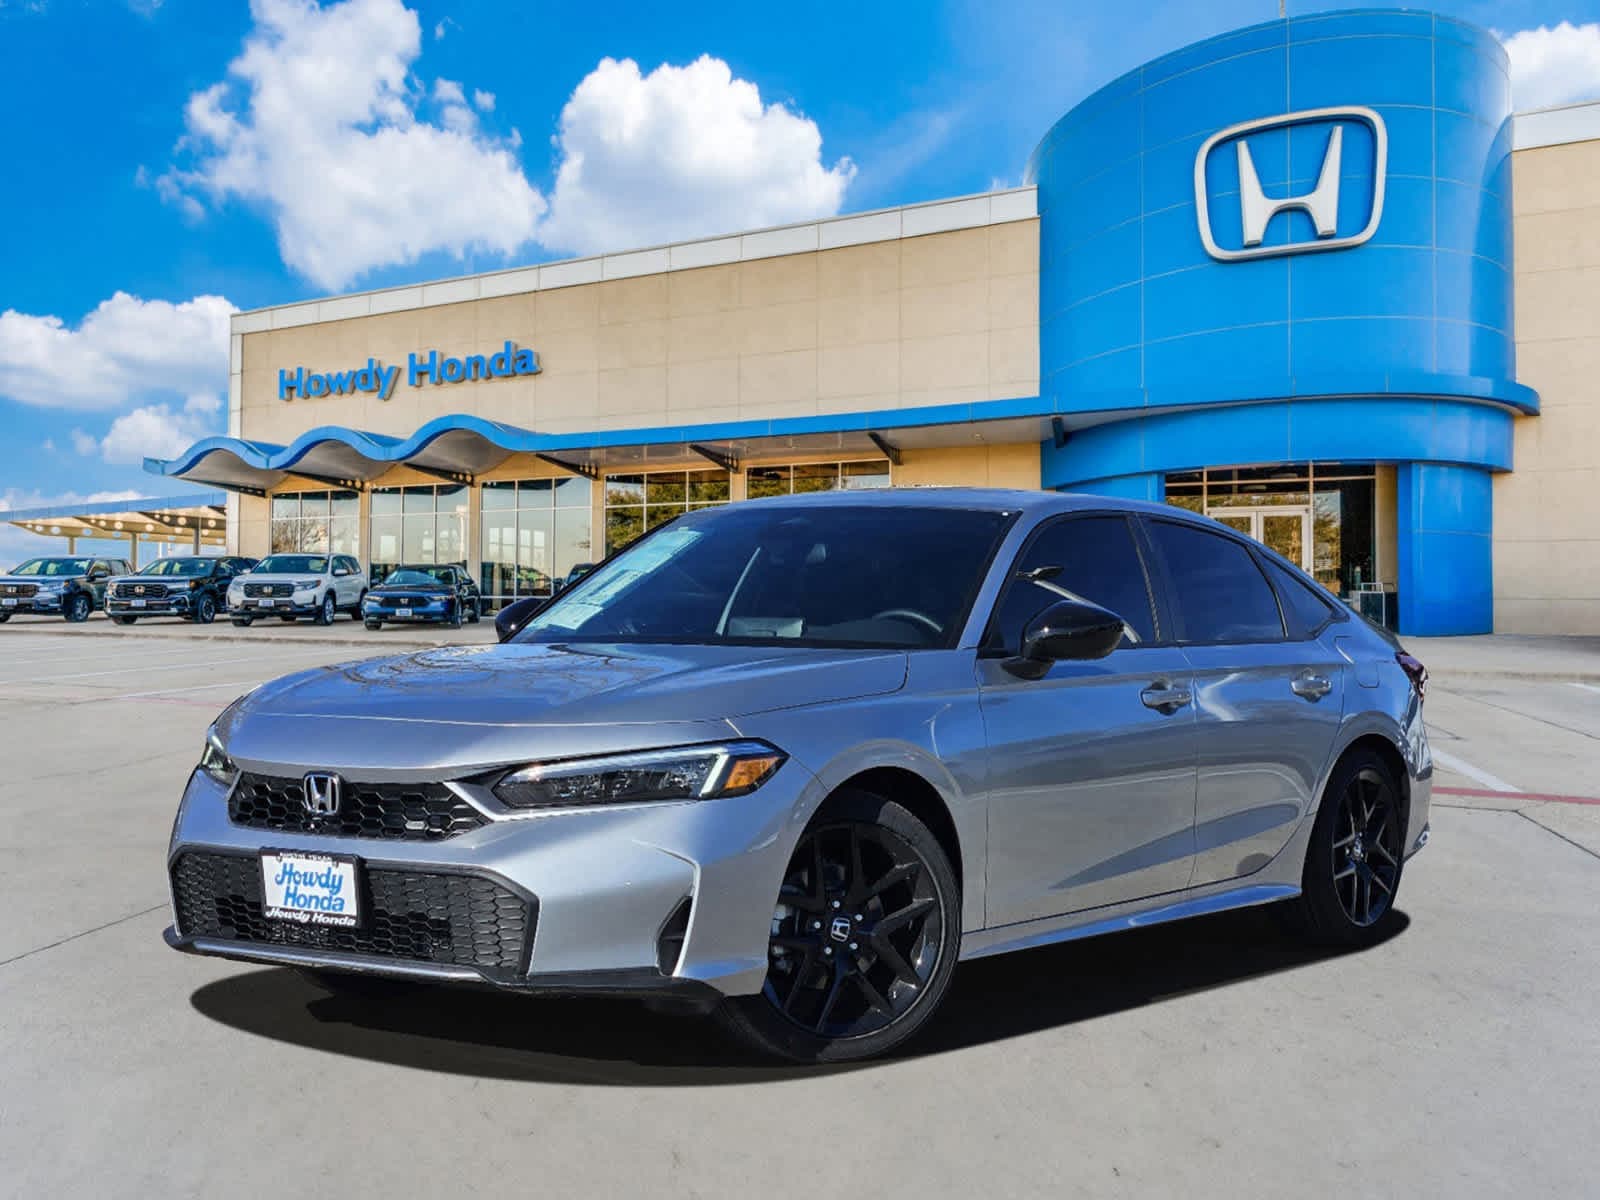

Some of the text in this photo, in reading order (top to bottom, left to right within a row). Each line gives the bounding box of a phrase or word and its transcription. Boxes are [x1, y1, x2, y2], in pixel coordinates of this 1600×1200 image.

[278, 340, 541, 401] Howdy Honda
[275, 863, 343, 894] Howdy
[284, 887, 345, 912] Honda
[265, 907, 356, 926] Howdy Honda
